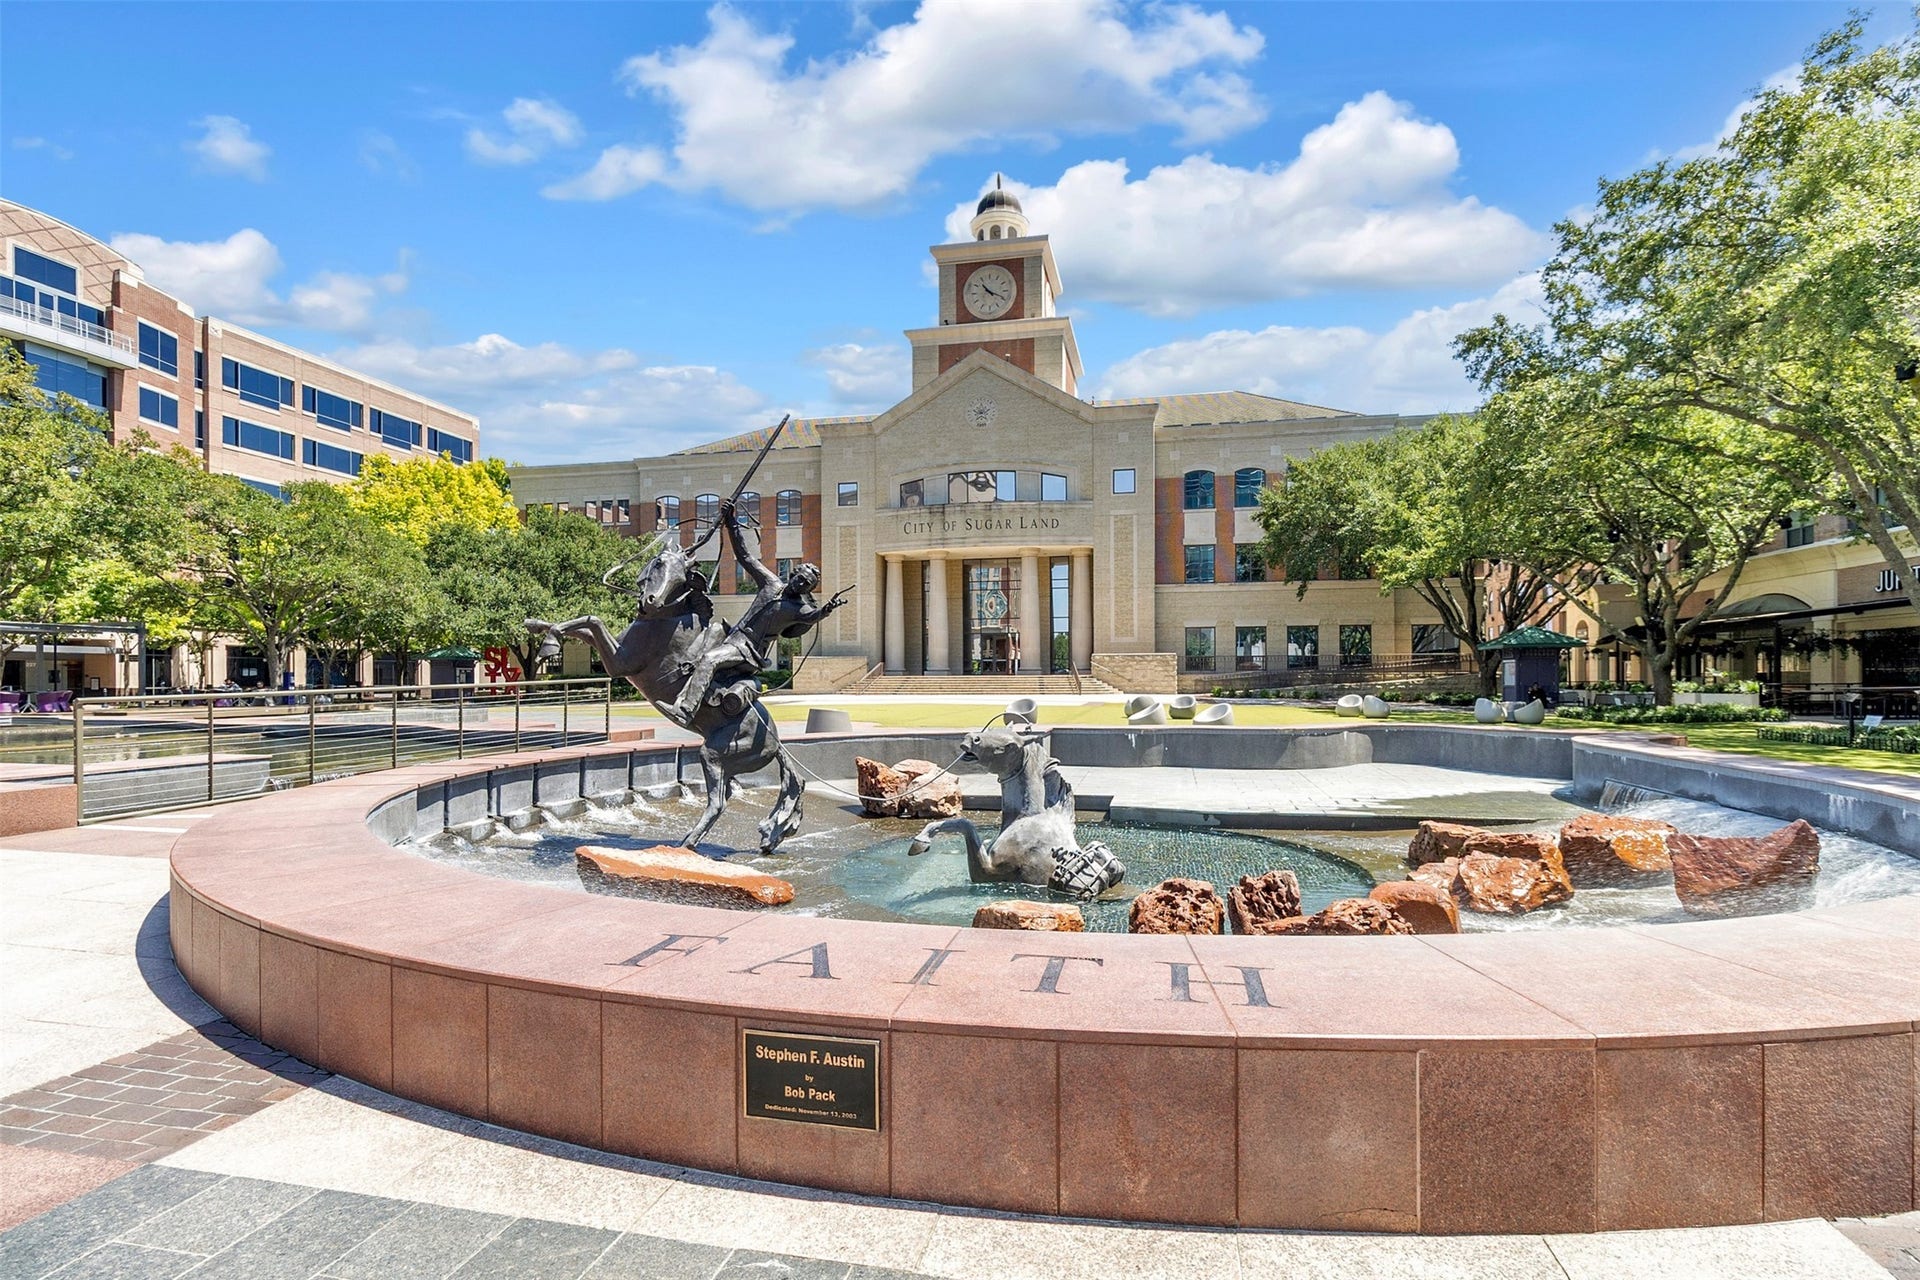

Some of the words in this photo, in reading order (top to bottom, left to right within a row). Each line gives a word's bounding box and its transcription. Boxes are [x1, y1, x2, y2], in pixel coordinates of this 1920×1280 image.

[903, 522, 934, 535] CITY
[965, 518, 1012, 530] SUGAR
[1020, 516, 1060, 529] LAND
[605, 933, 1281, 1008] FAITH
[755, 1045, 807, 1063] Stephen
[810, 1050, 820, 1064] F.
[823, 1052, 865, 1068] Austin
[804, 1074, 814, 1082] by
[784, 1085, 805, 1098] Bob
[808, 1088, 836, 1102] Pack
[798, 1107, 829, 1116] November
